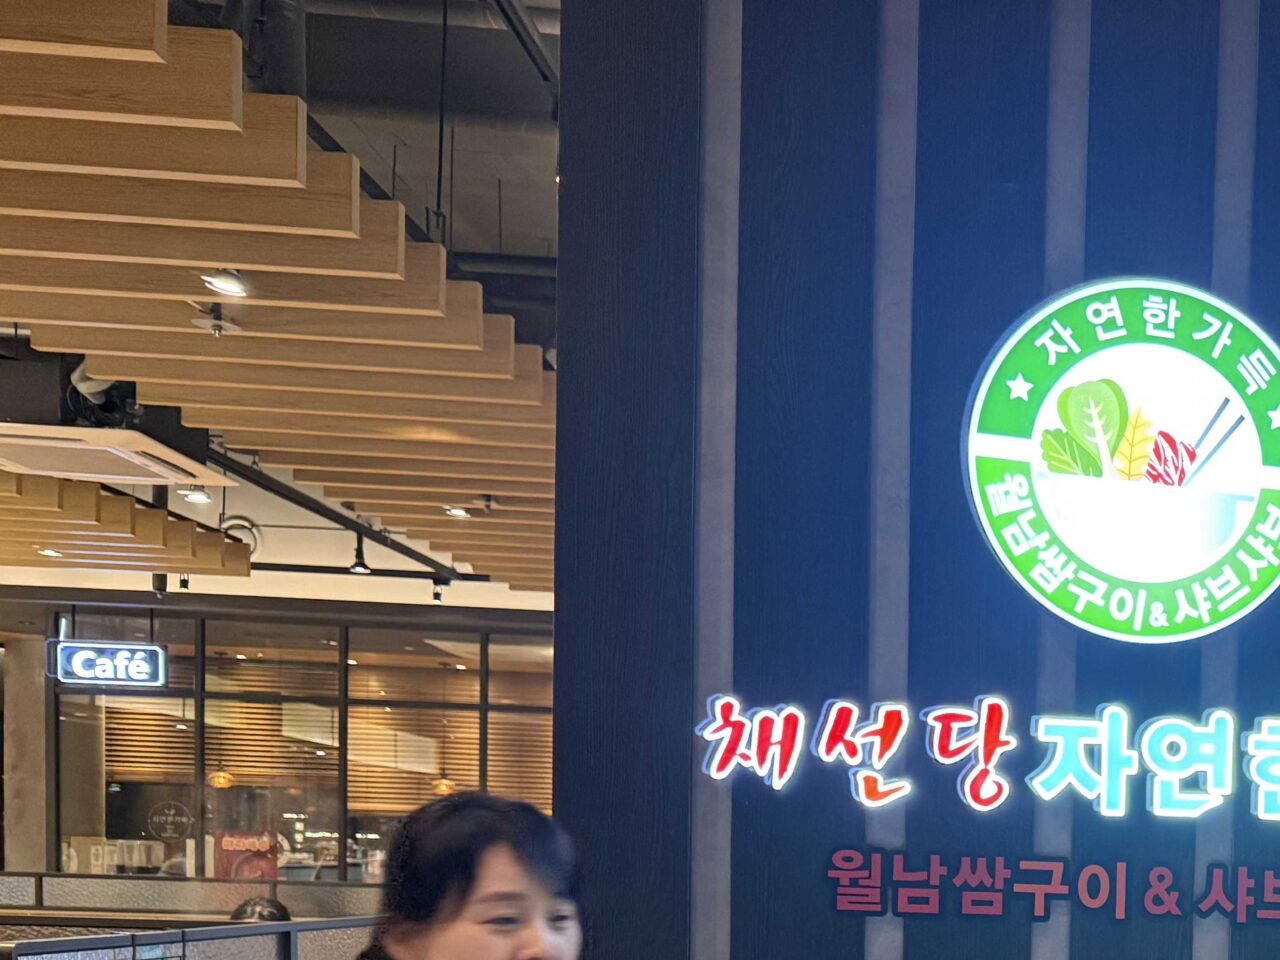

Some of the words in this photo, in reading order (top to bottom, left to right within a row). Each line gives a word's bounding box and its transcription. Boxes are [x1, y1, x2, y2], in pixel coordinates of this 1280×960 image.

[1034, 295, 1277, 395] 자연한가득
[71, 650, 151, 680] Café
[700, 696, 1016, 811] 채선당
[827, 849, 1126, 919] 월남쌈구이
[1144, 867, 1182, 915] &
